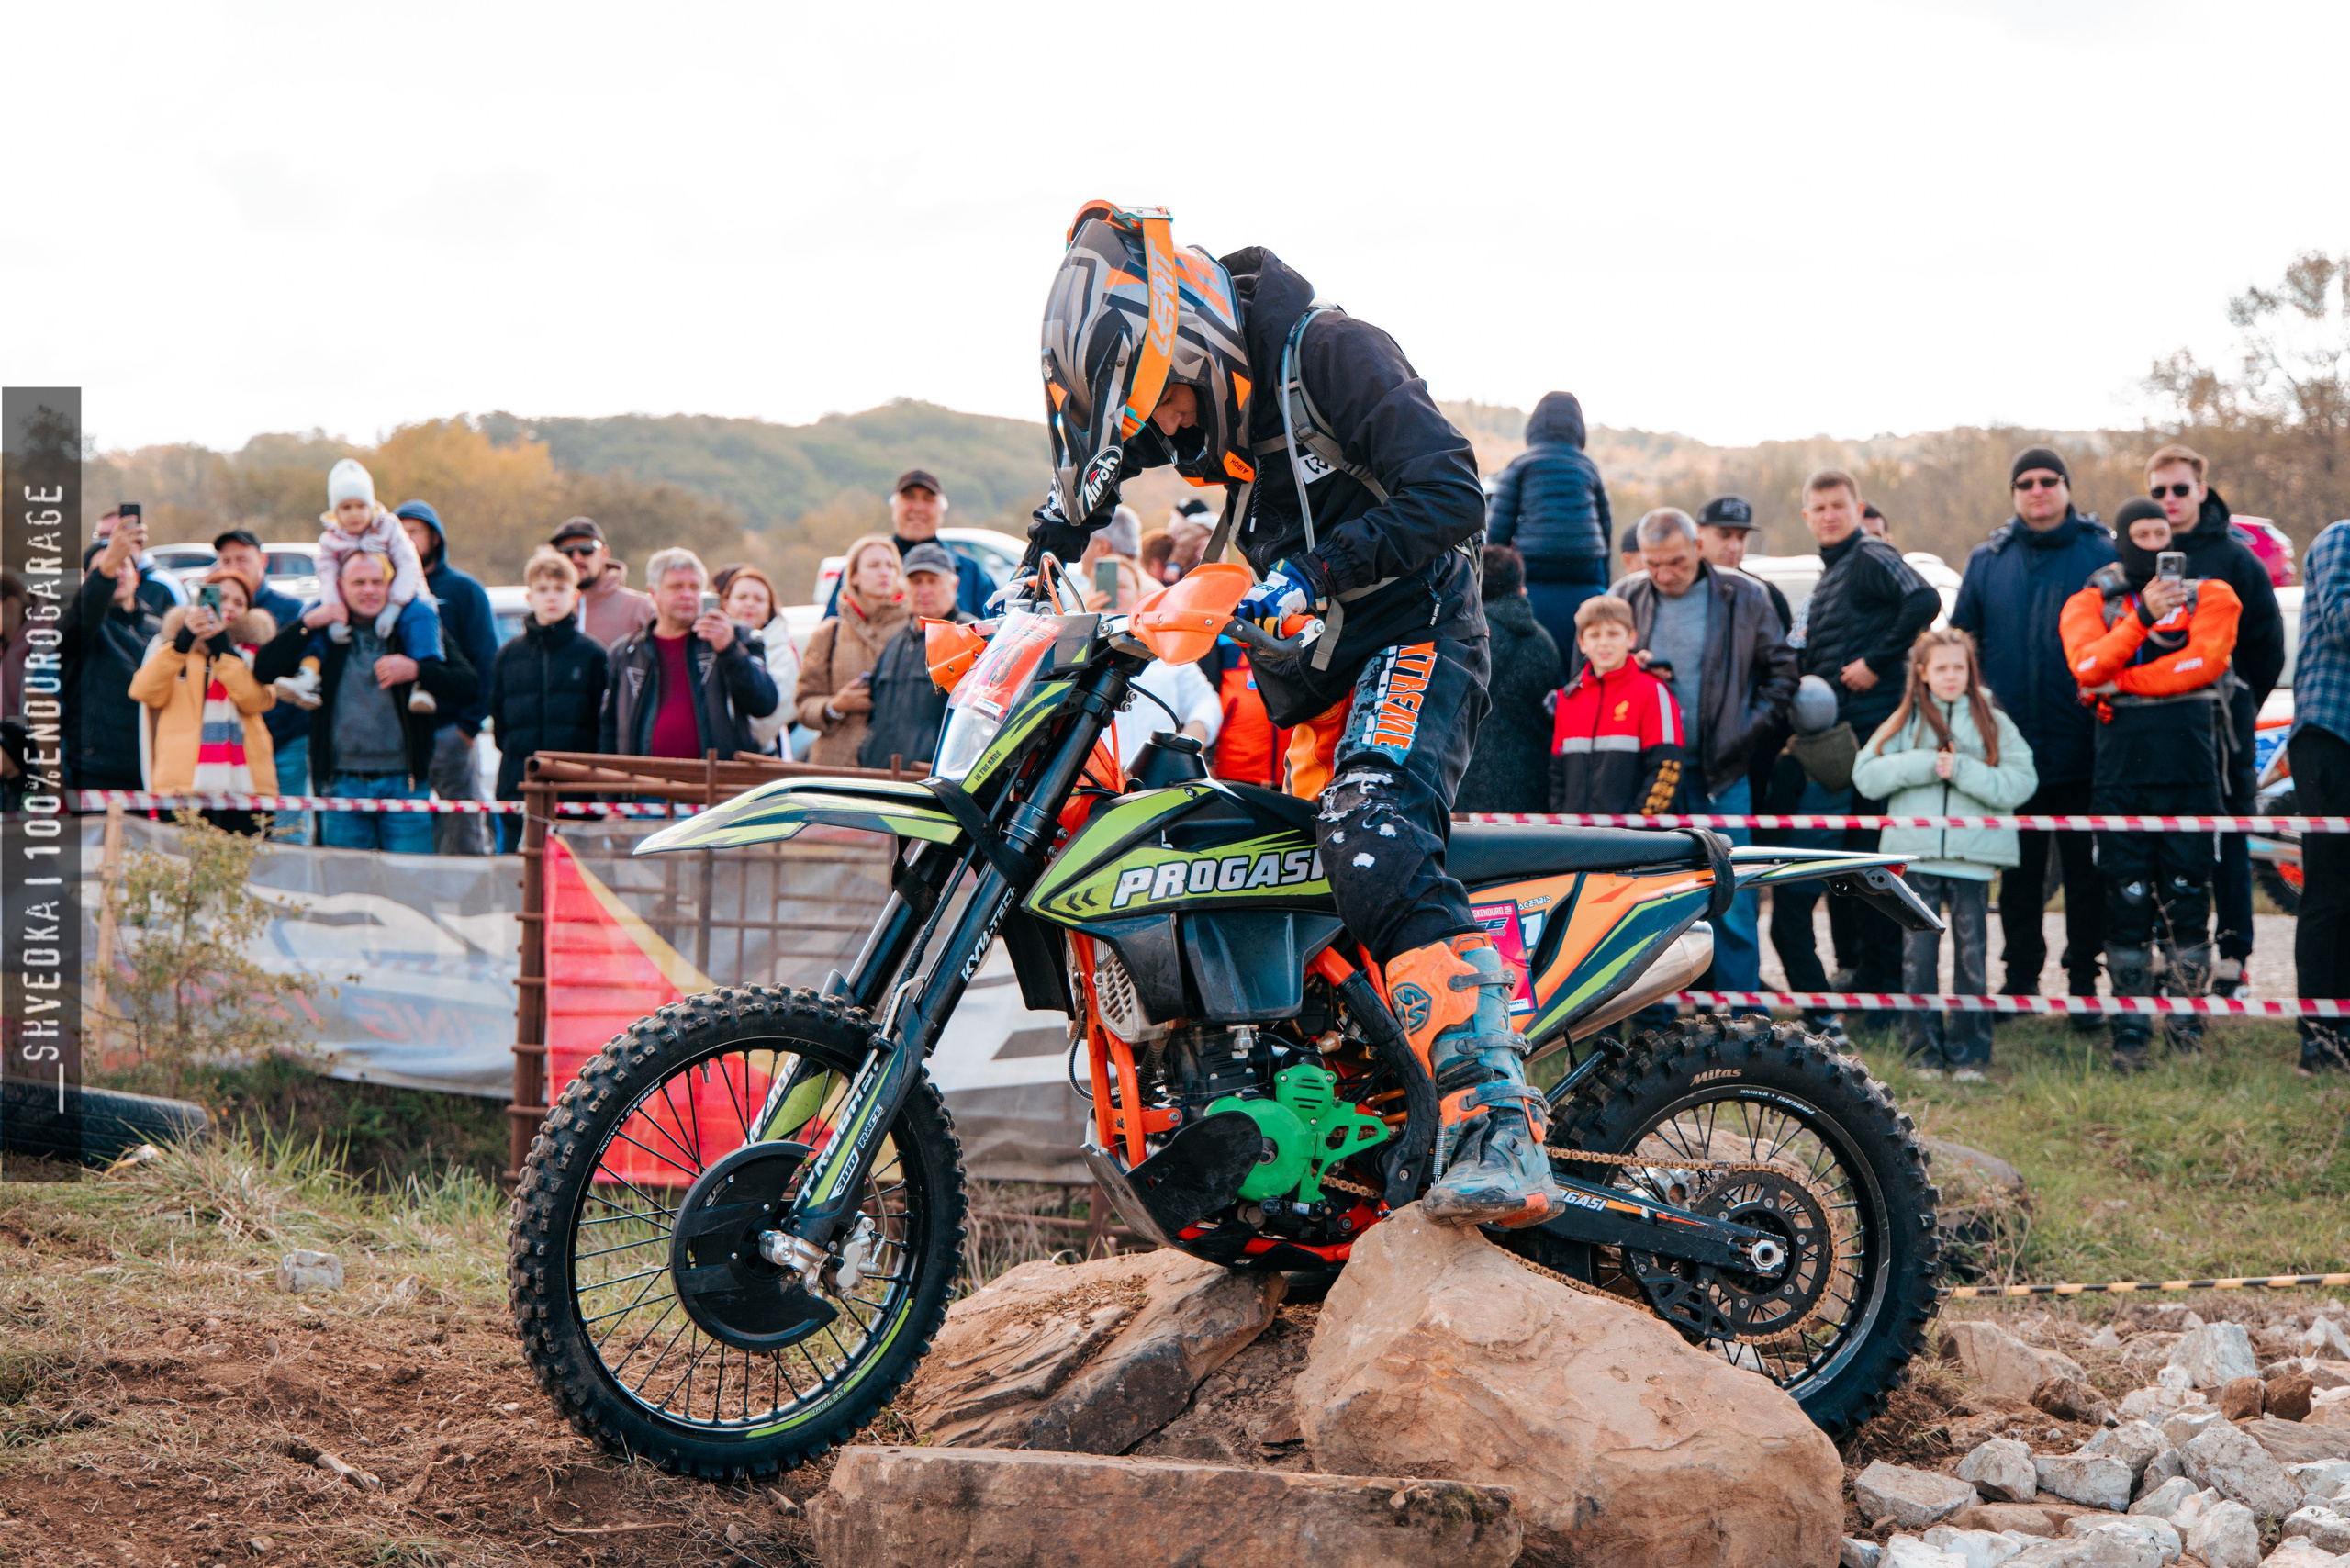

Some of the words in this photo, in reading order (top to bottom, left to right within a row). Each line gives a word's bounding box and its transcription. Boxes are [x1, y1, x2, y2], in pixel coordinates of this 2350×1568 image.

[1230, 458, 1249, 474] AIROH
[1084, 456, 1119, 513] Airoh
[974, 772, 982, 782] IN
[979, 763, 990, 776] THE
[988, 749, 1002, 766] RACE
[1111, 848, 1326, 908] PROGASI
[1689, 1068, 1742, 1087] Mitas
[1776, 1095, 1816, 1115] PROGASI
[835, 1156, 858, 1193] 300
[857, 1103, 884, 1149] RACE
